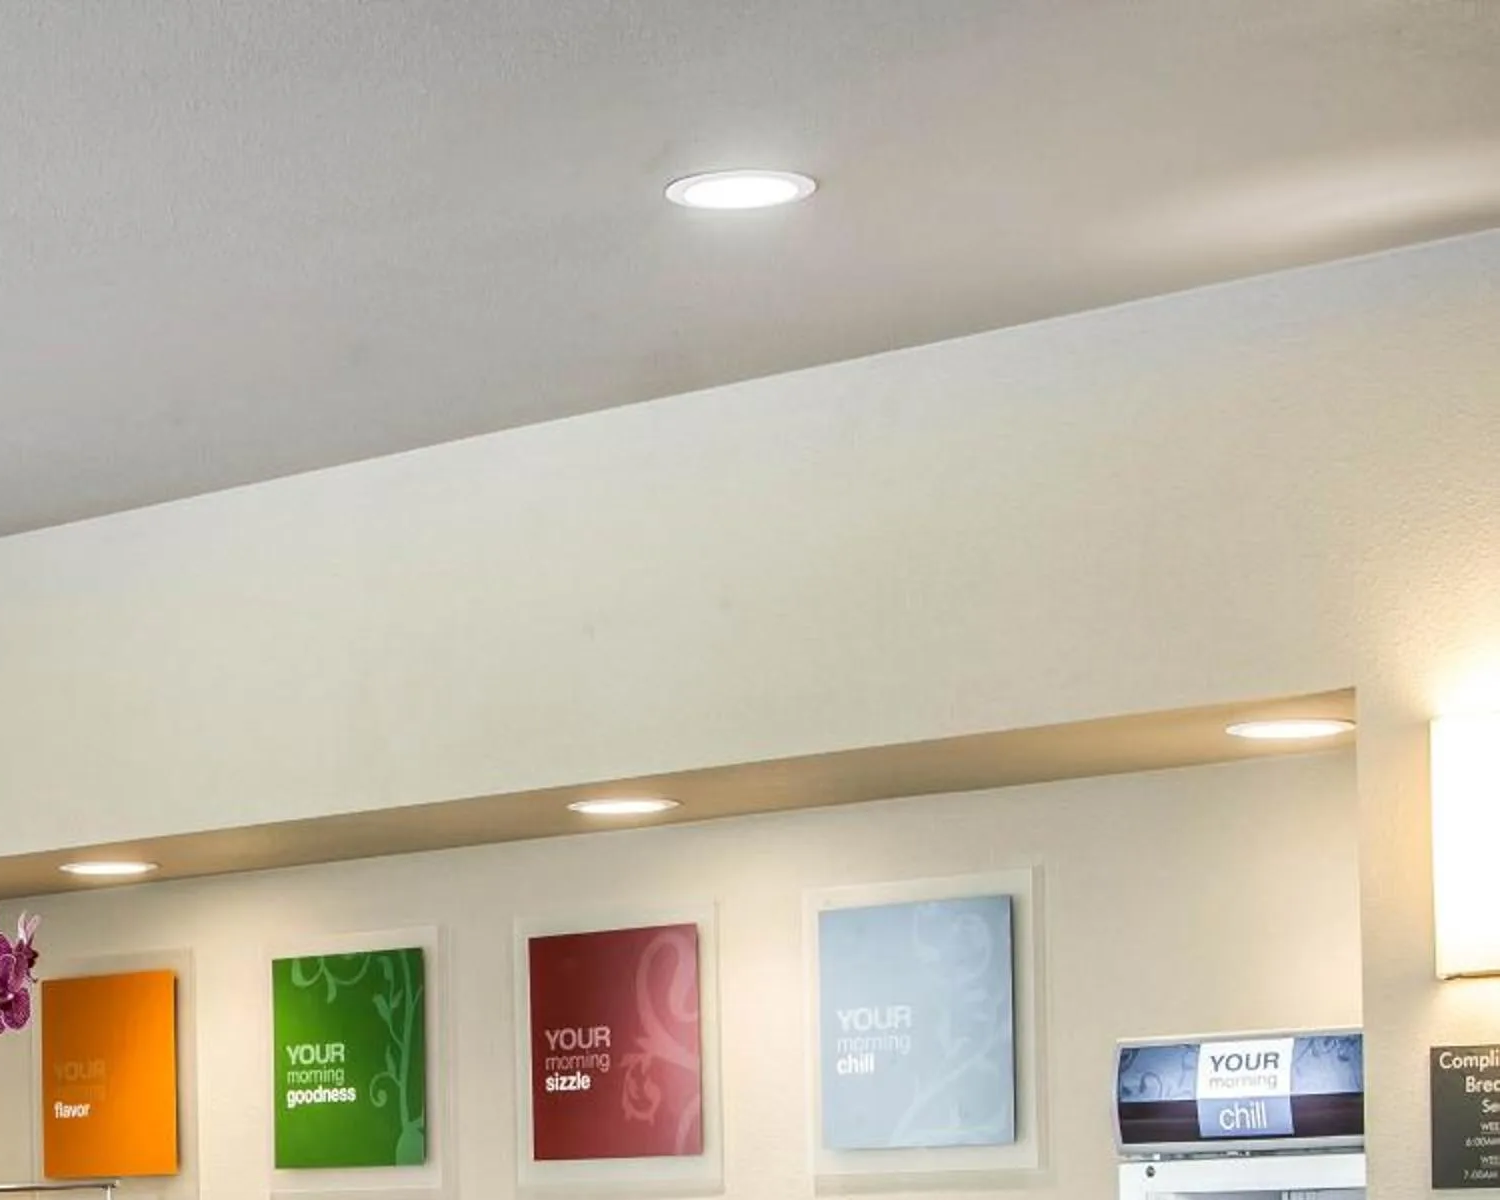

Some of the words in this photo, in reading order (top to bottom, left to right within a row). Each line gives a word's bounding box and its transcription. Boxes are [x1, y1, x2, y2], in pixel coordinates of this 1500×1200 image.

[835, 1005, 912, 1032] YOUR
[545, 1026, 611, 1051] YOUR
[837, 1032, 911, 1056] morning
[286, 1041, 345, 1065] YOUR
[545, 1050, 610, 1073] morning
[836, 1052, 875, 1075] chill
[1209, 1051, 1280, 1072] YOUR
[286, 1065, 345, 1086] morning
[545, 1071, 591, 1092] sizzle
[1208, 1074, 1278, 1091] morning
[286, 1084, 357, 1108] goodness
[54, 1100, 91, 1119] flavor
[1219, 1100, 1268, 1130] chill
